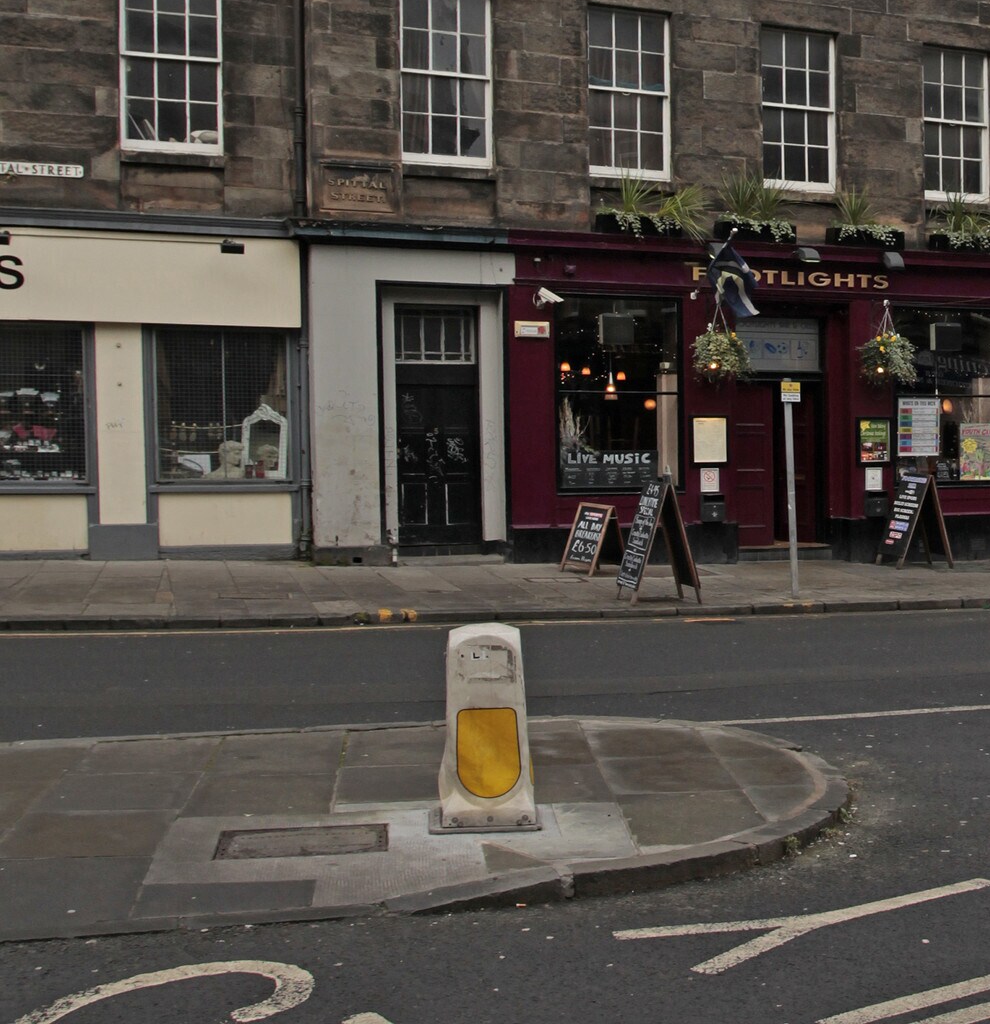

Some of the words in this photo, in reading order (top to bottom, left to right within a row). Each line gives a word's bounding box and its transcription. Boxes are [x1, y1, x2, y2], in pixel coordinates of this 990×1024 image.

[328, 178, 387, 190] SPITTAL
[692, 267, 889, 289] FTLIGHTS
[567, 453, 597, 464] LIVE
[577, 520, 589, 529] ALL
